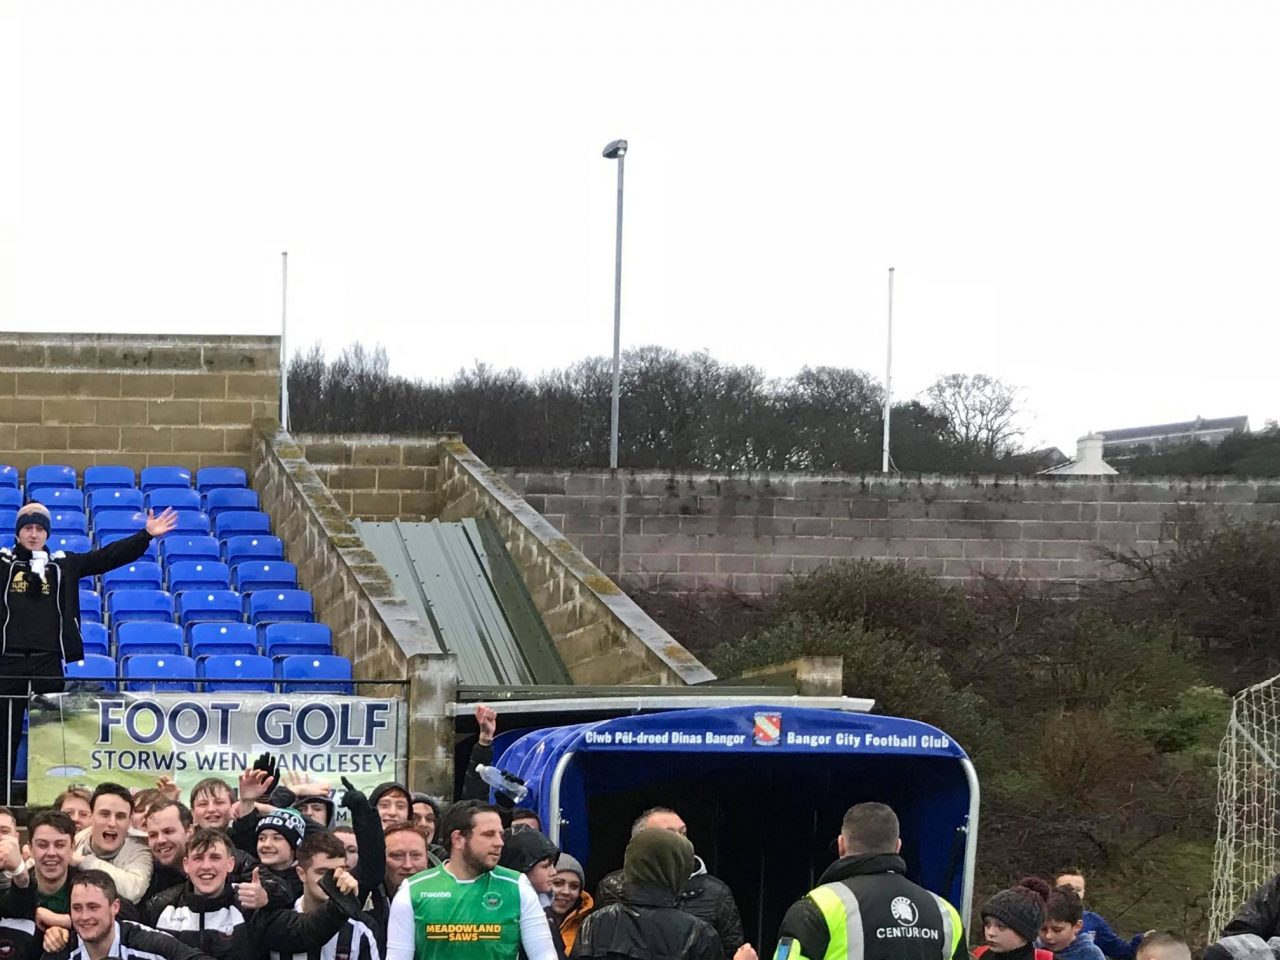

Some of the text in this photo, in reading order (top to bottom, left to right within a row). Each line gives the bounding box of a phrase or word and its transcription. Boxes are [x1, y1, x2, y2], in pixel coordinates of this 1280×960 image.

[95, 699, 391, 748] FOOT GOLF
[585, 731, 949, 748] Clwb Pêl-droed Dinas Bangor Bangor City Football Club
[91, 750, 387, 773] STORWS WEN ANGLESEY
[426, 924, 501, 933] MEADOWLAND
[448, 933, 479, 941] SAWS
